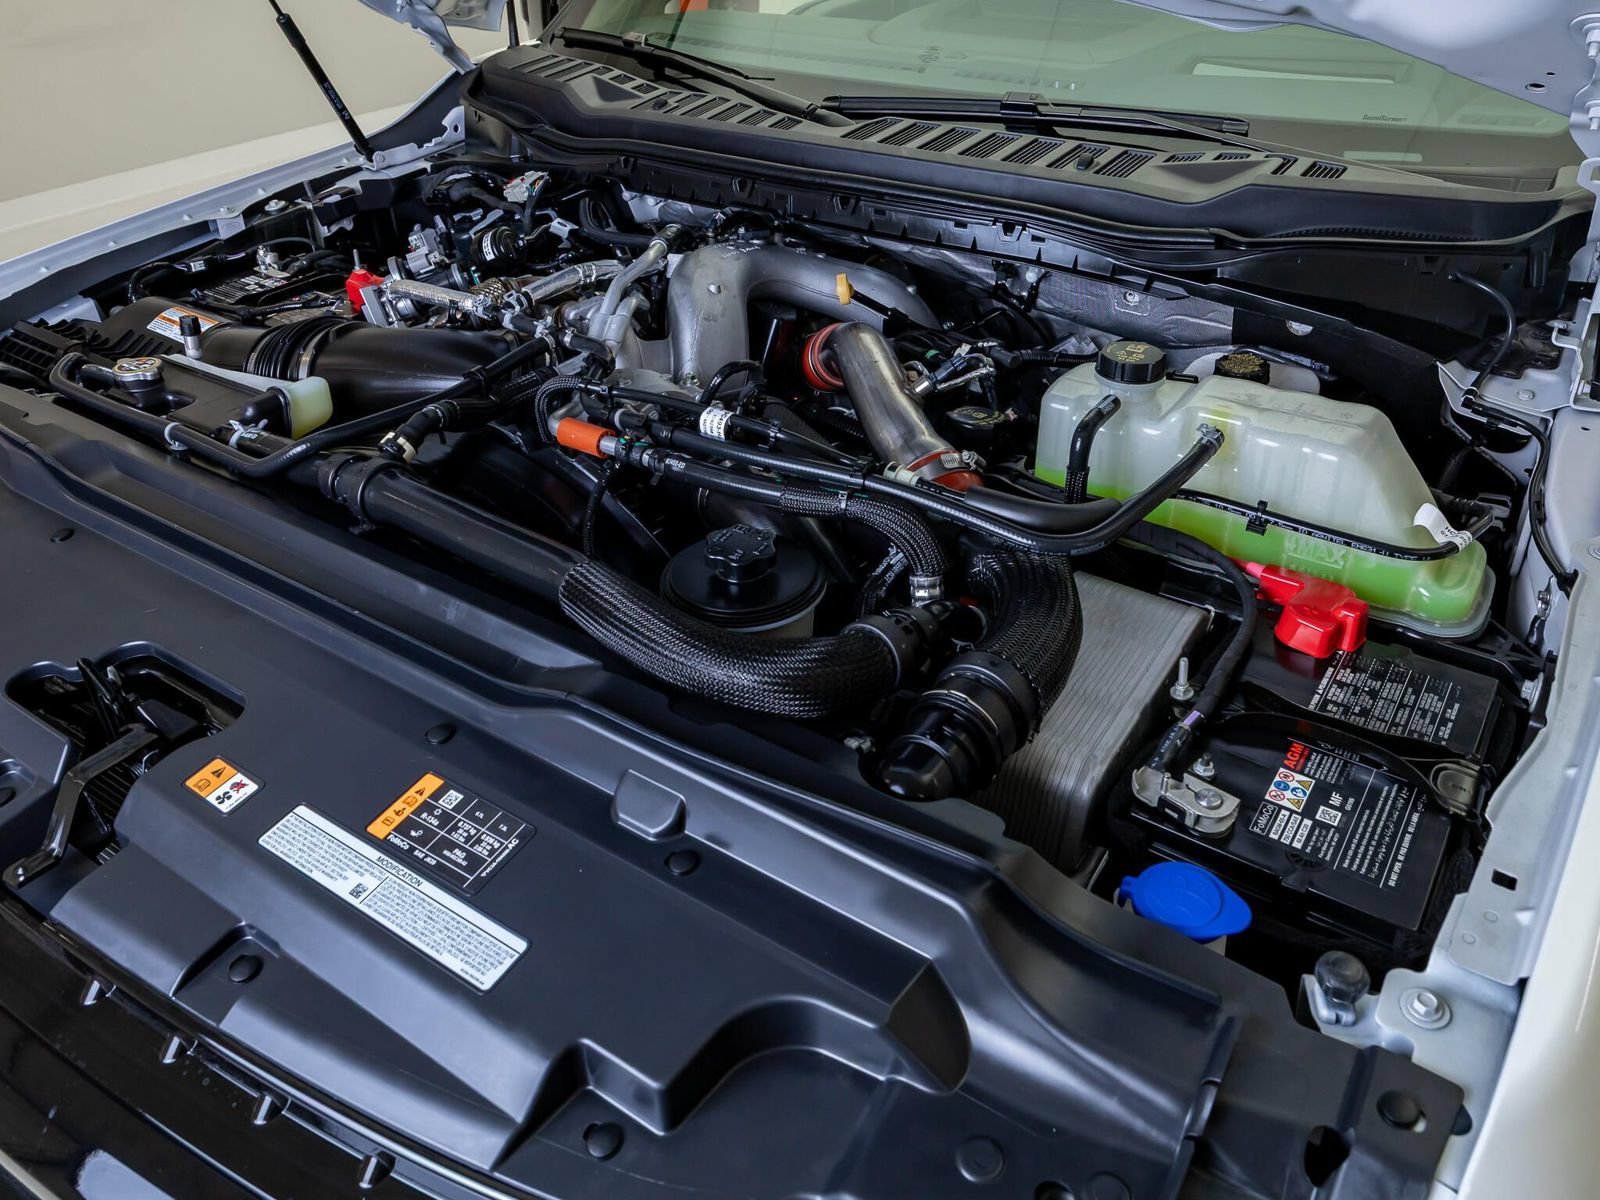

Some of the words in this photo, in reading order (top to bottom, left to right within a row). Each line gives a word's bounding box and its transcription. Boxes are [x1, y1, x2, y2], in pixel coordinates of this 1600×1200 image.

[1283, 742, 1304, 768] AGM
[1328, 791, 1344, 806] MF
[419, 812, 439, 826] R-134a
[1253, 803, 1274, 832] FoMoCo
[468, 827, 477, 835] kg
[386, 834, 410, 850] FoMoCo
[412, 849, 425, 858] SAE
[491, 840, 501, 849] kg
[451, 848, 466, 859] PAG
[375, 855, 423, 887] MODIFICATION
[1389, 870, 1398, 881] NOT
[1387, 878, 1396, 887] DO
